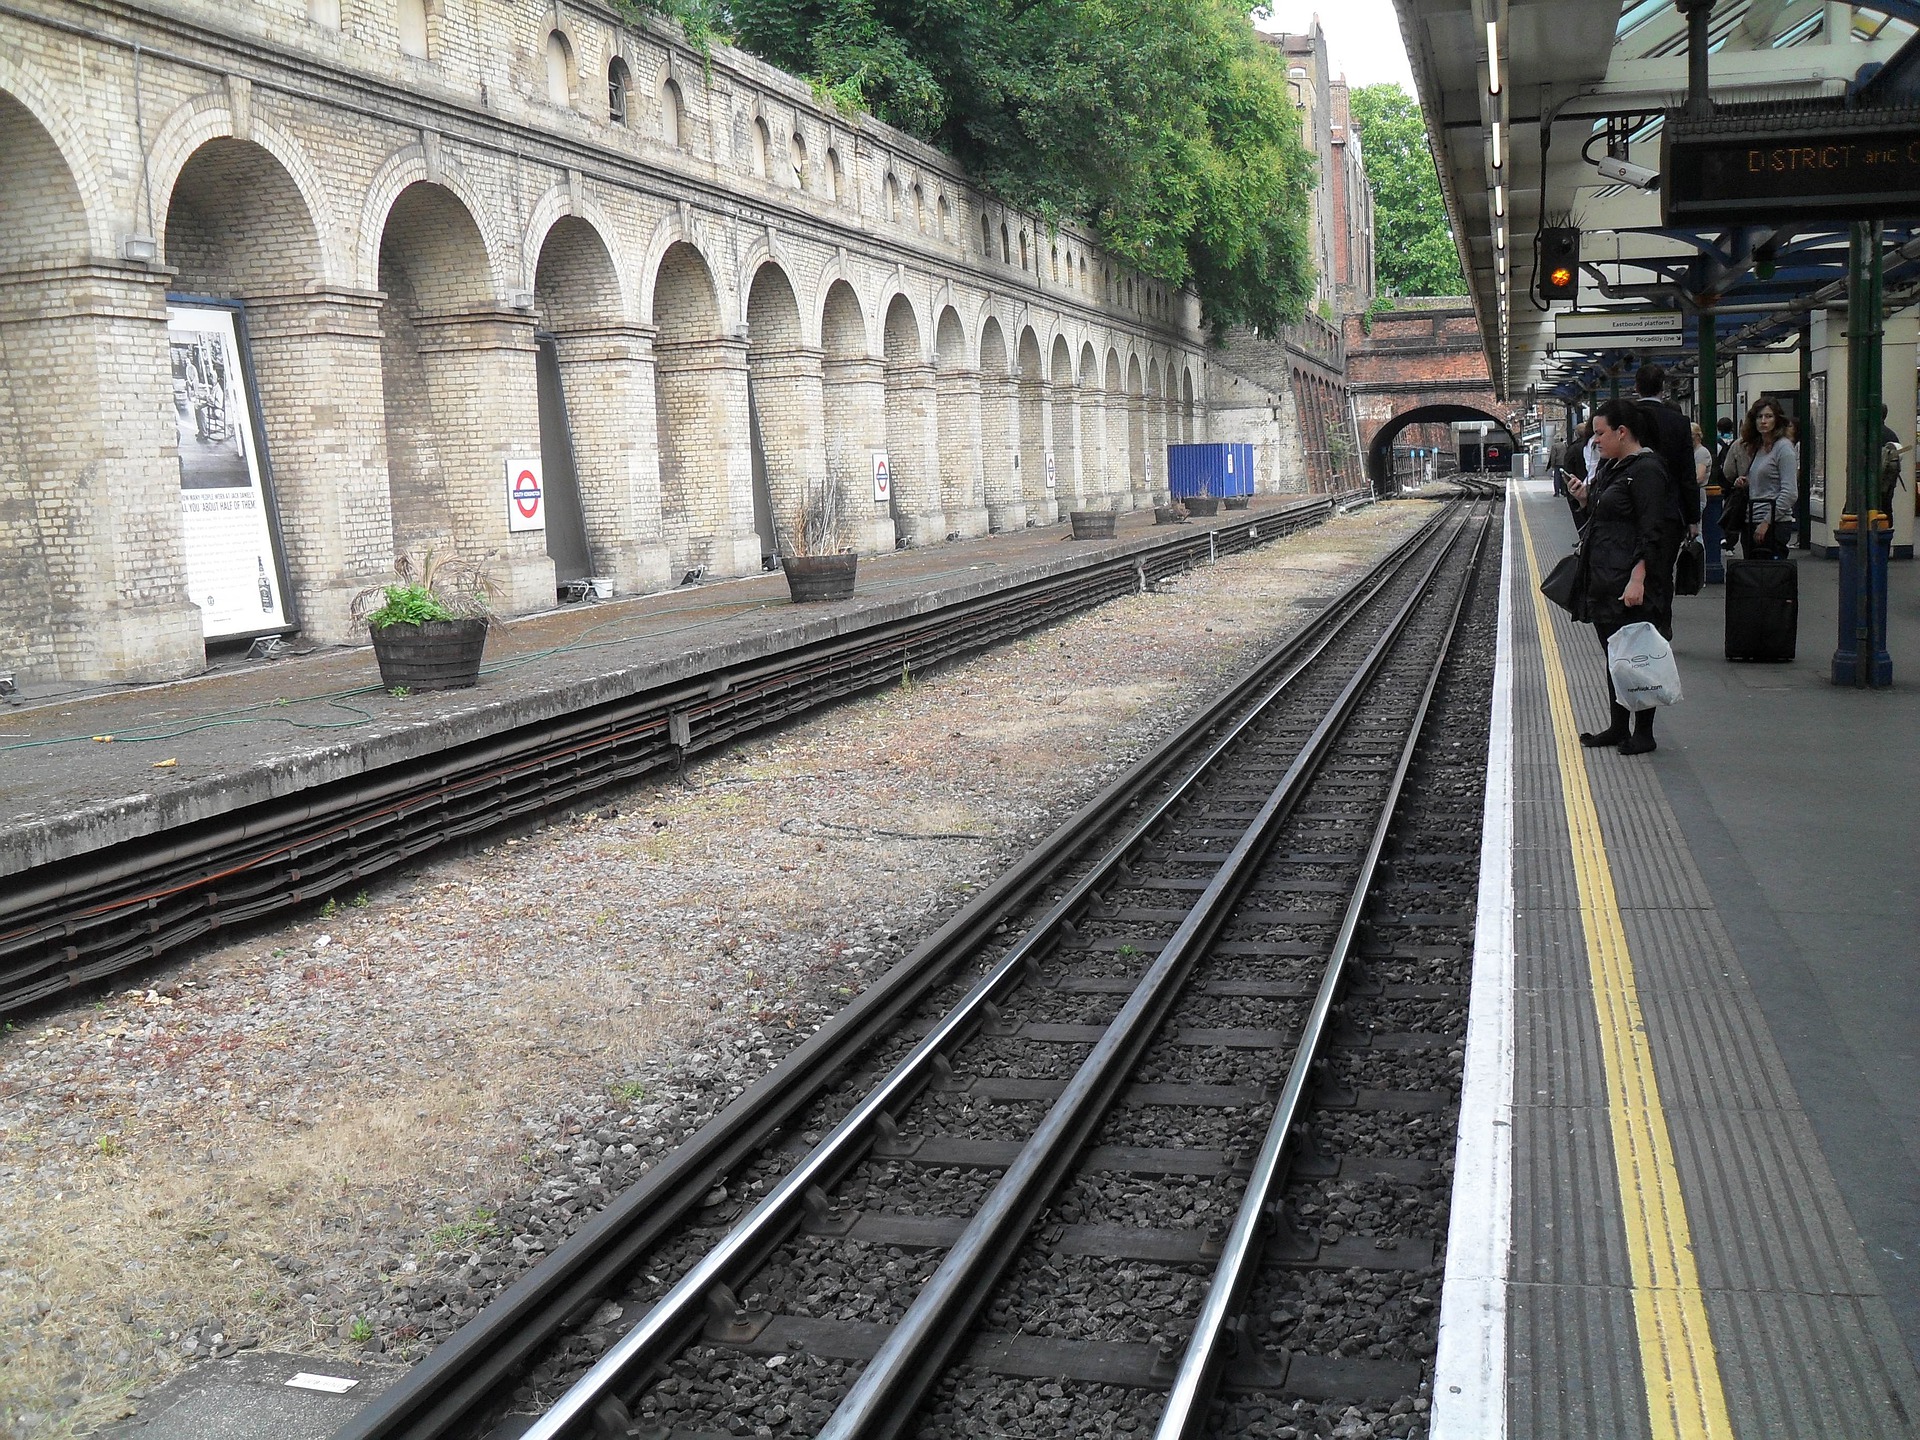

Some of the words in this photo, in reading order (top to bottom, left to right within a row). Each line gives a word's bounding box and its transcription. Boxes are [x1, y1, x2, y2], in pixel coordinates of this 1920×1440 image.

[1612, 320, 1643, 328] Eastbound
[1644, 320, 1670, 328] platform
[1635, 335, 1663, 343] Piccadilly
